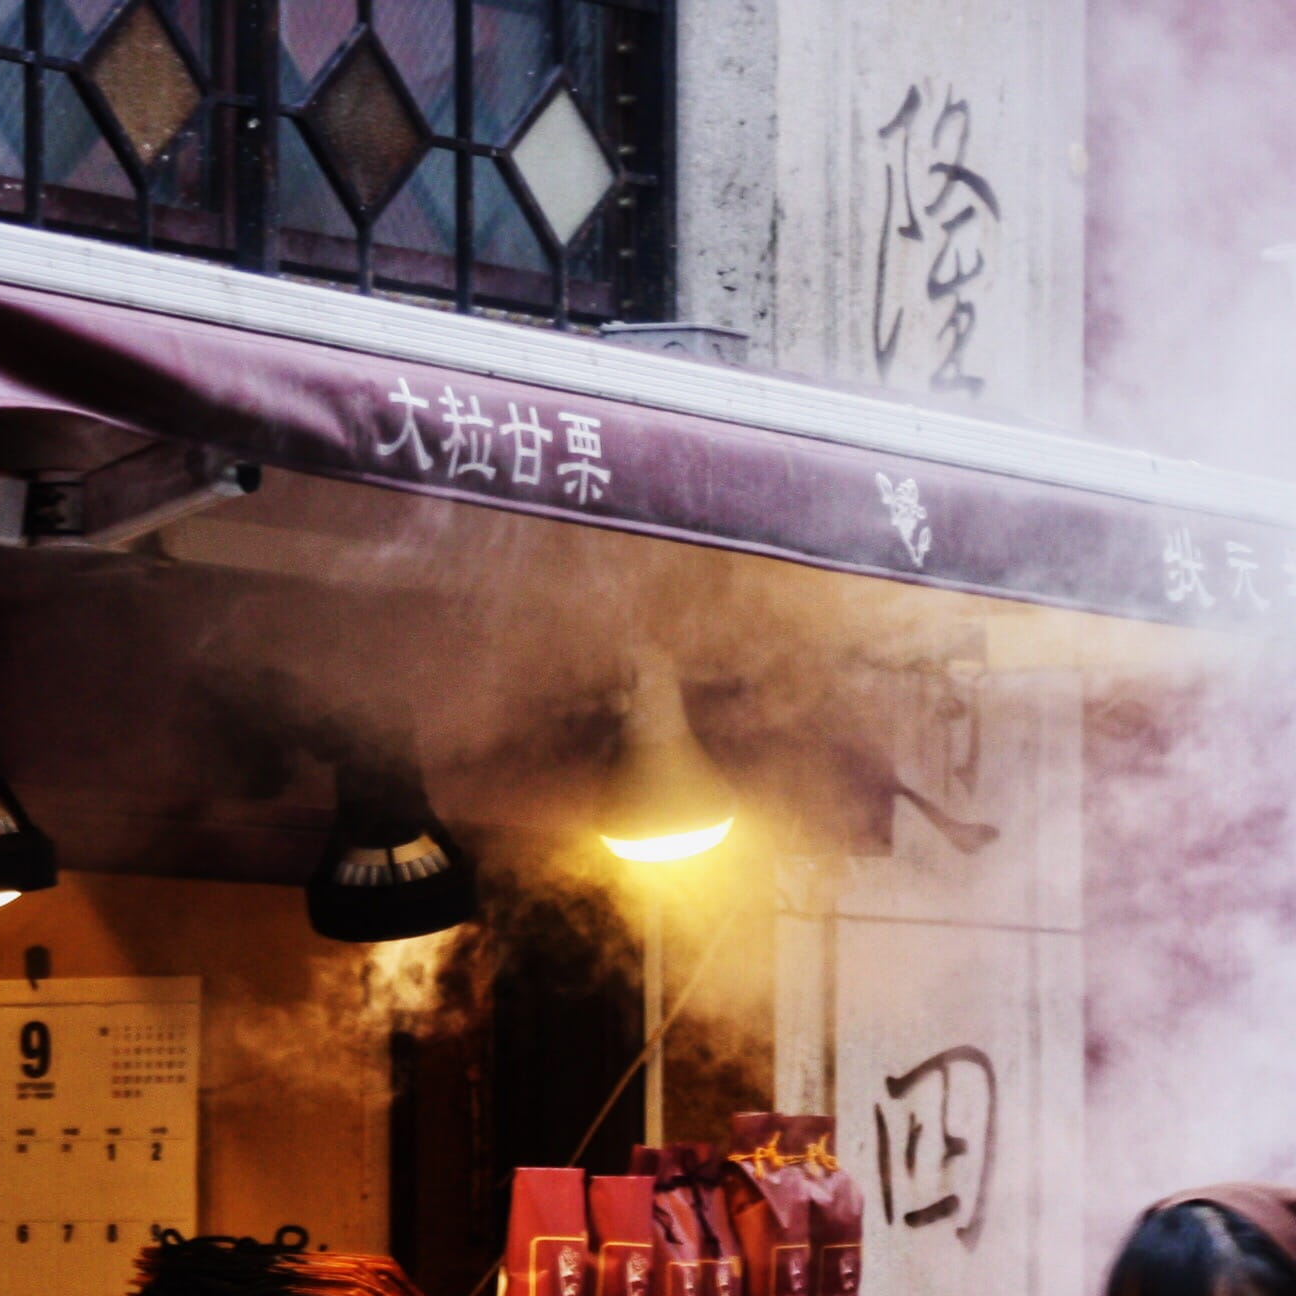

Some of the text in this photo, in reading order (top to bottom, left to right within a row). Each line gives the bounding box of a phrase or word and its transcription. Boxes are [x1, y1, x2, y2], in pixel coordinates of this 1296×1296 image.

[376, 378, 612, 504] 大粒甘栗
[20, 1021, 51, 1079] 9
